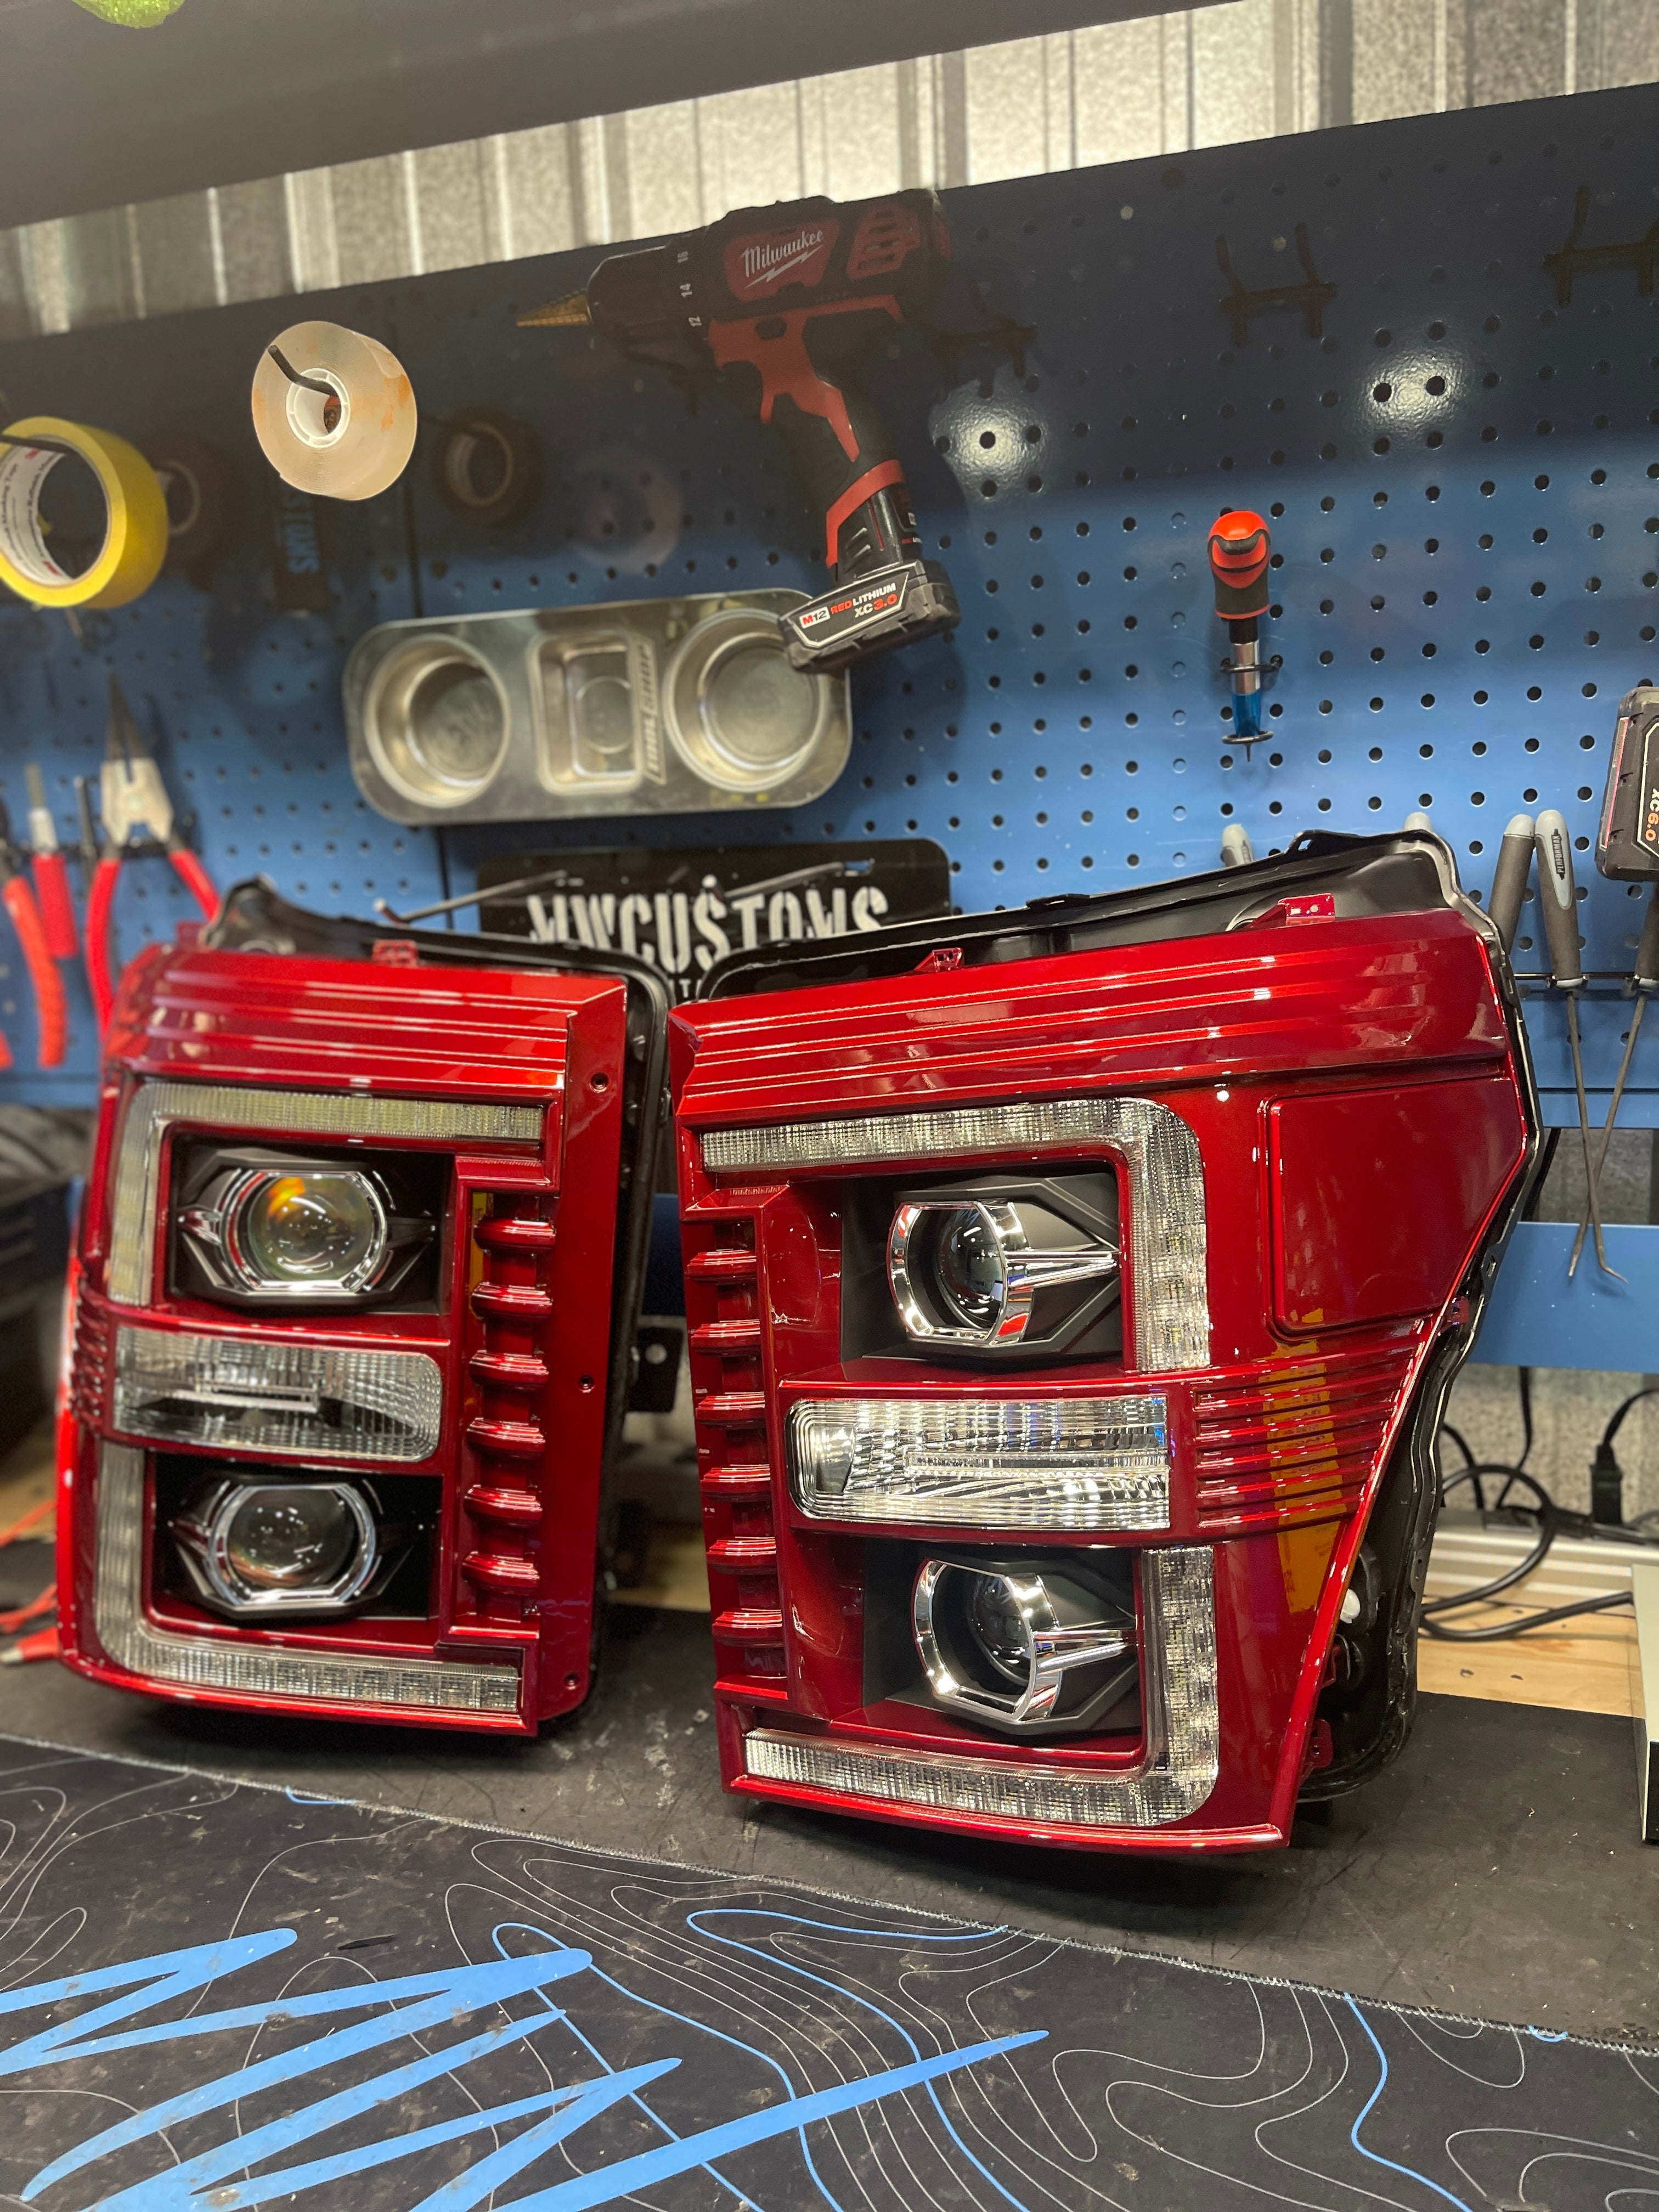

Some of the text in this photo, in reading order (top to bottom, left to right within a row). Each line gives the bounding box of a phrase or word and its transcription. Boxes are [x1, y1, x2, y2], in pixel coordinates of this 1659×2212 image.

[740, 230, 823, 277] Milwaukee
[680, 283, 692, 298] 14
[689, 317, 702, 328] 12
[802, 611, 827, 625] M12
[1553, 836, 1565, 873] PERFORMAX
[529, 887, 889, 973] MWCUSTOMS
